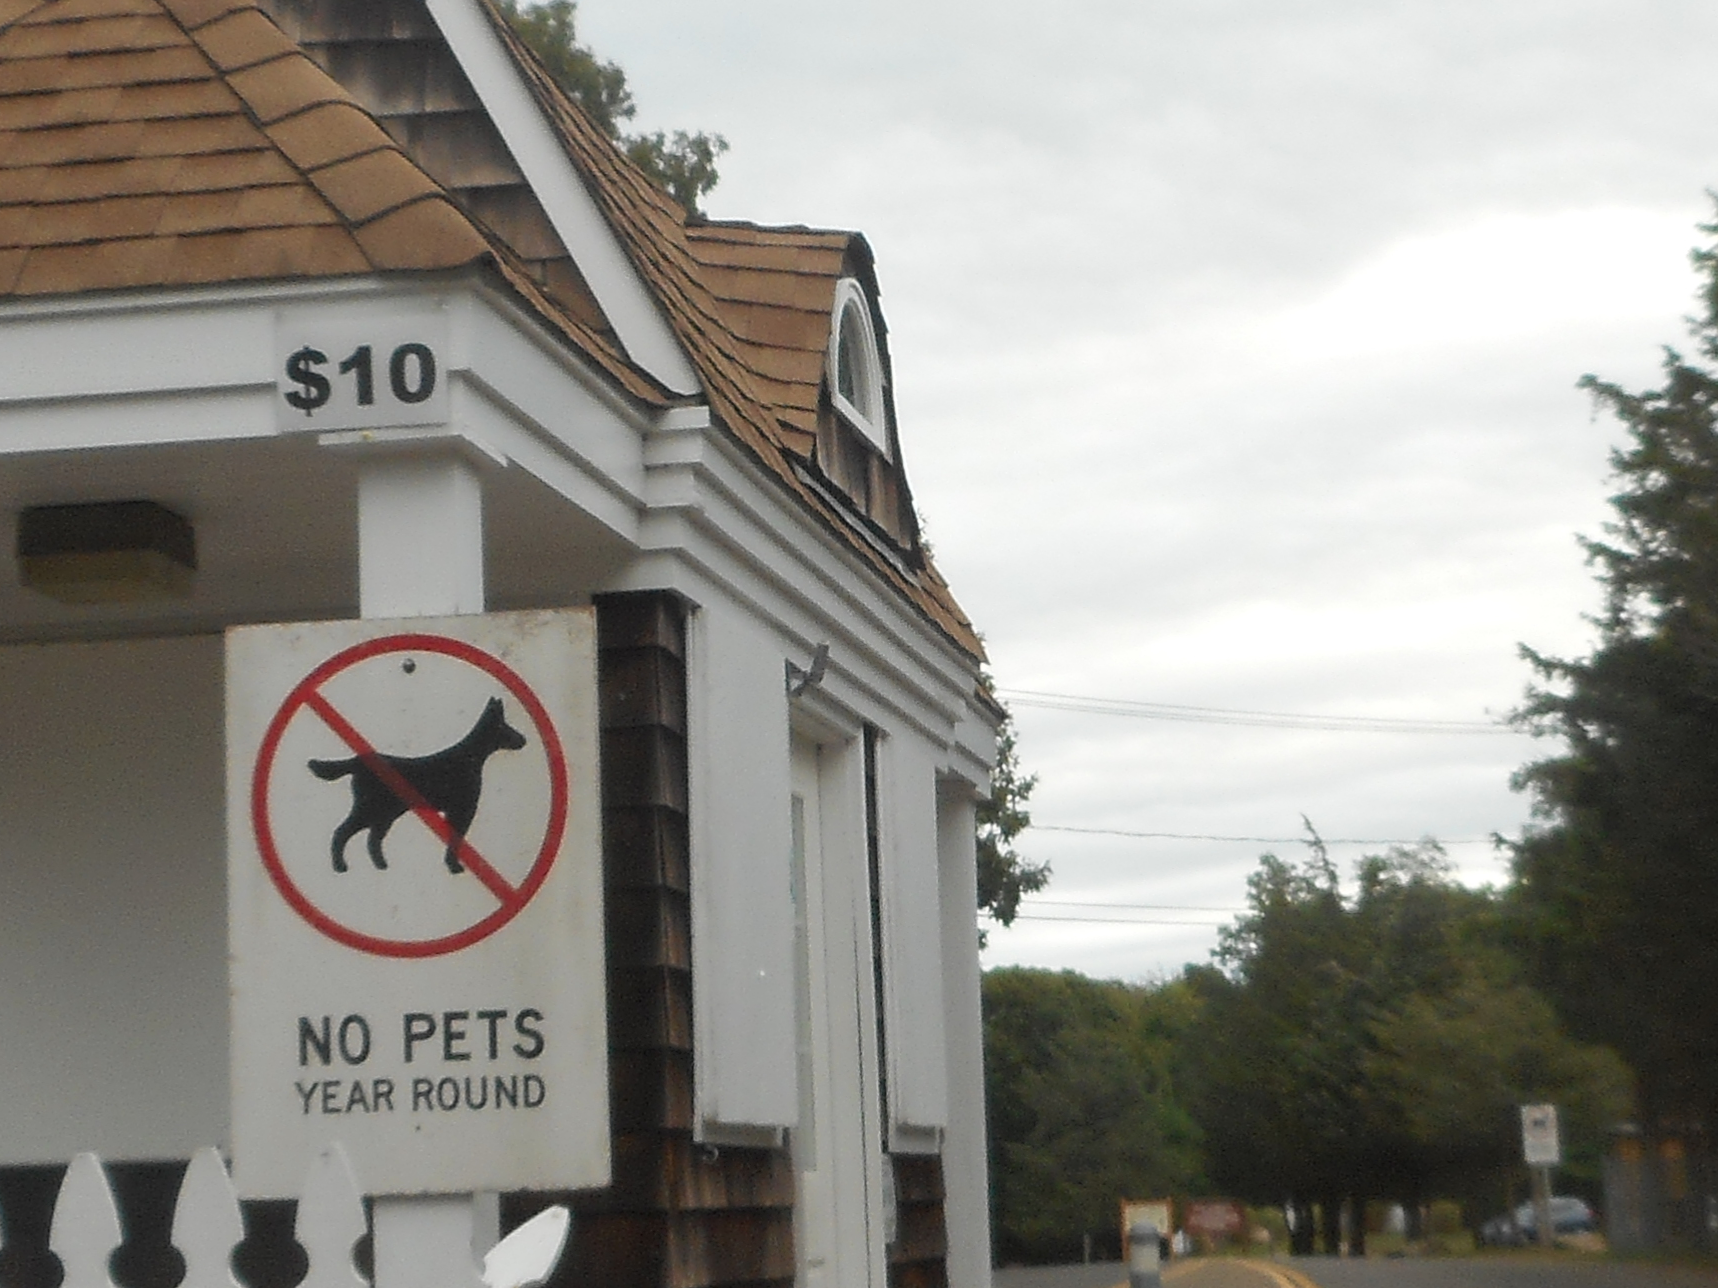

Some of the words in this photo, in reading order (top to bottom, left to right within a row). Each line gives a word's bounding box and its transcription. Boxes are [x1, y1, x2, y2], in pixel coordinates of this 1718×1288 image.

[284, 342, 437, 417] $10
[298, 1013, 372, 1067] NO
[403, 1008, 546, 1062] PETS
[295, 1078, 396, 1115] YEAR
[411, 1073, 546, 1111] ROUND
